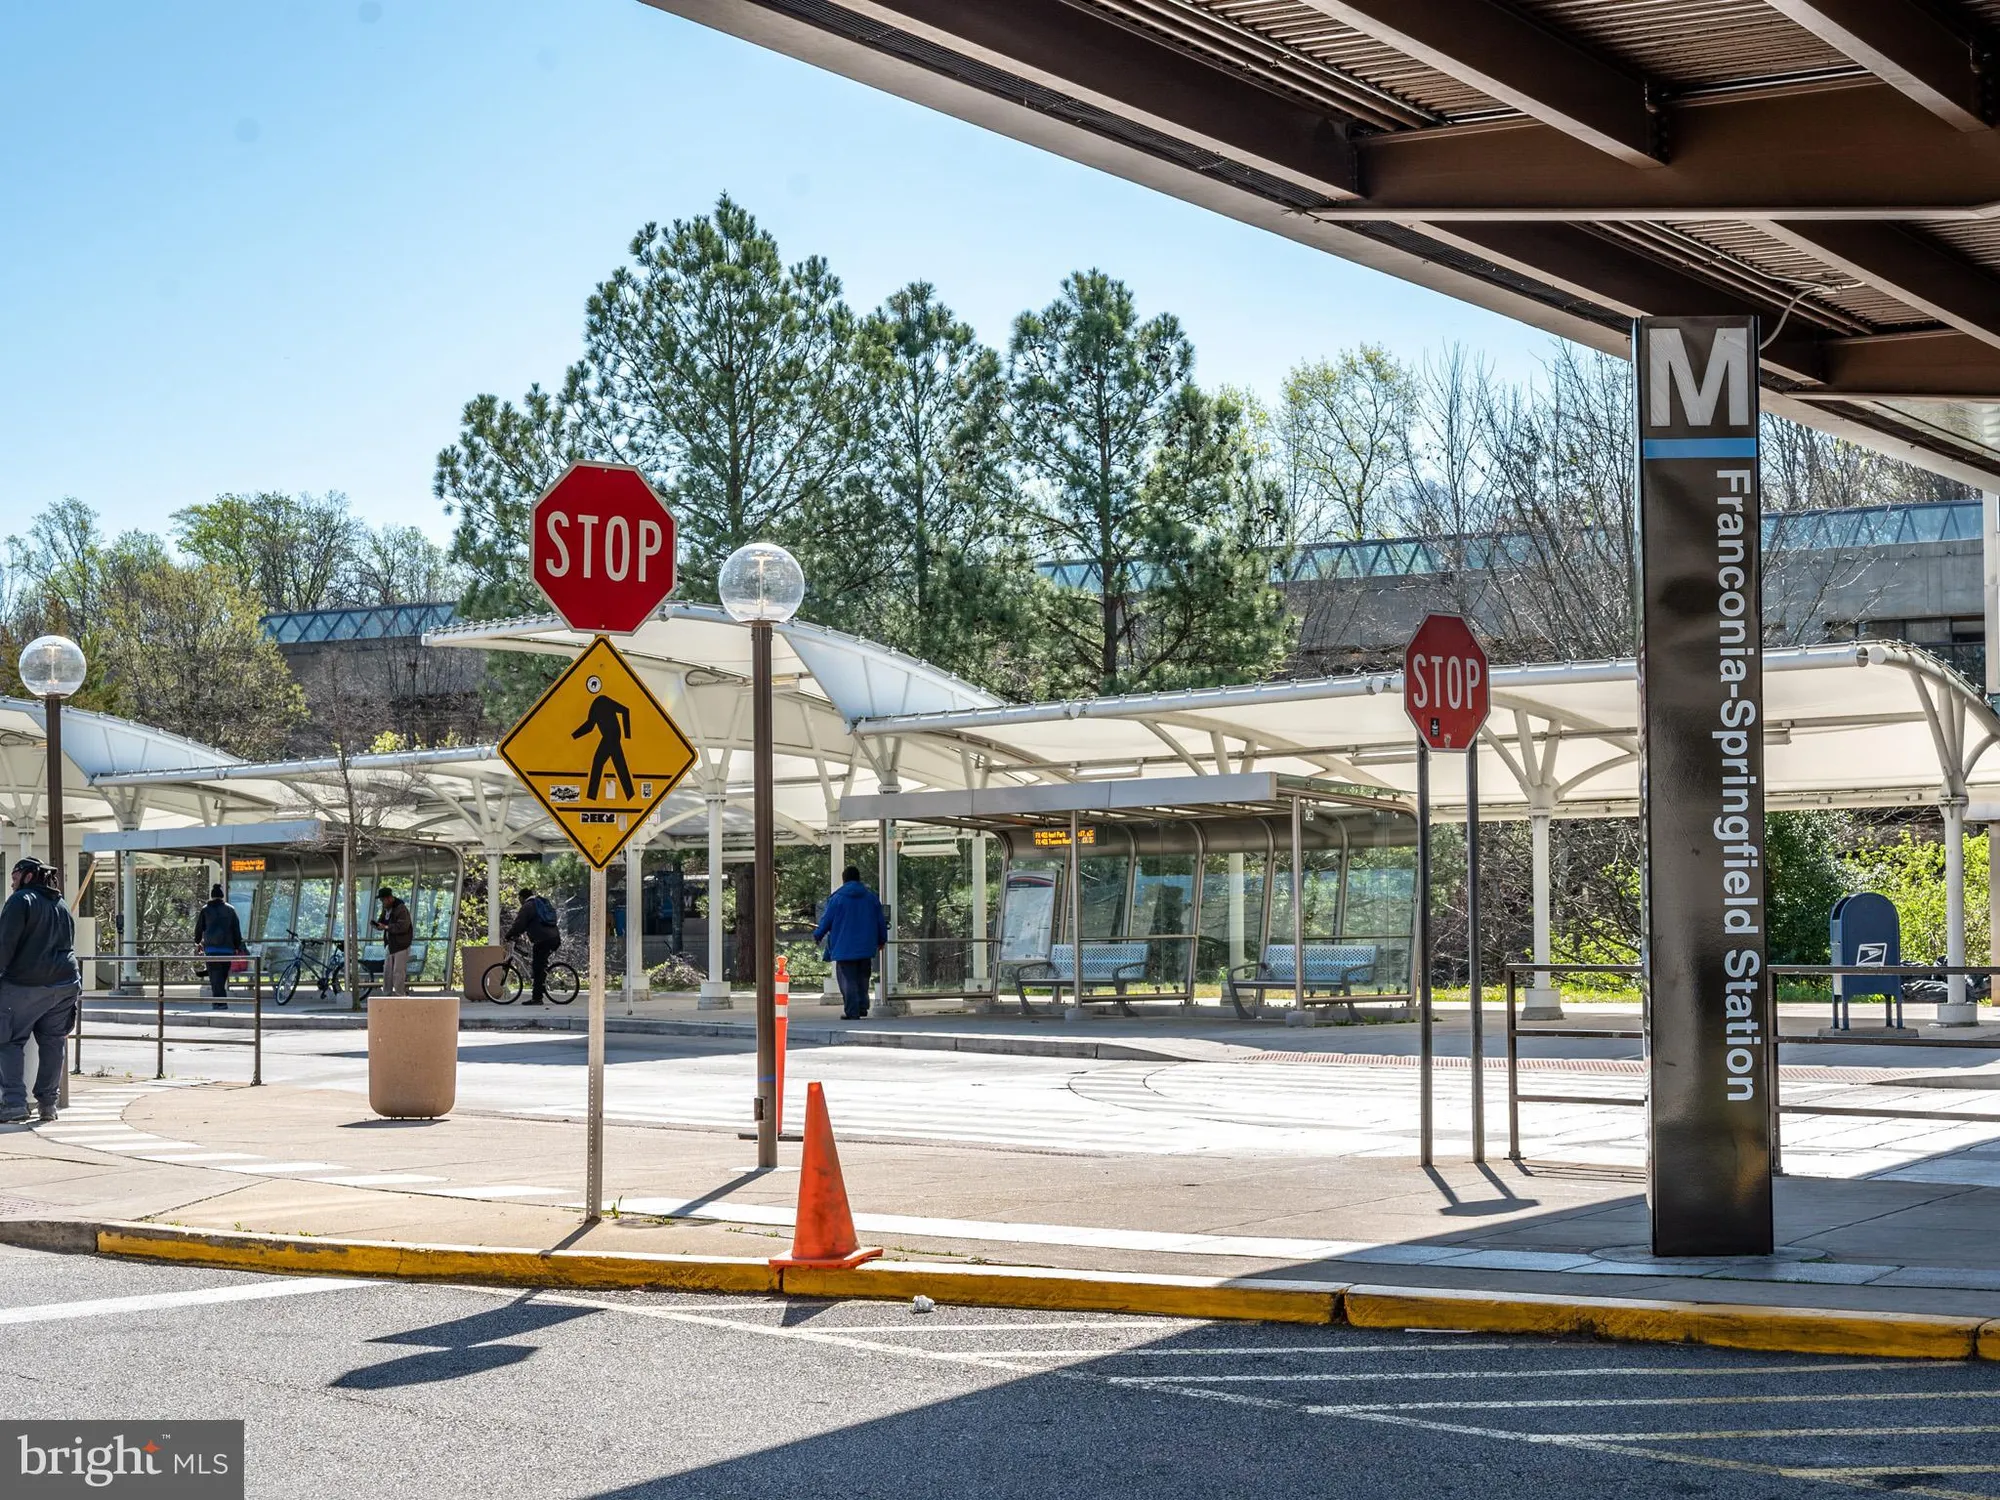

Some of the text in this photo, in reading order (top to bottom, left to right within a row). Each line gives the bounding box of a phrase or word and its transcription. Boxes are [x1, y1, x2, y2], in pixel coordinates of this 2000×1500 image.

[1649, 328, 1750, 427] M
[545, 510, 663, 583] STOP
[1413, 653, 1481, 710] STOP
[1711, 469, 1761, 1101] Franconia-Springfield Station
